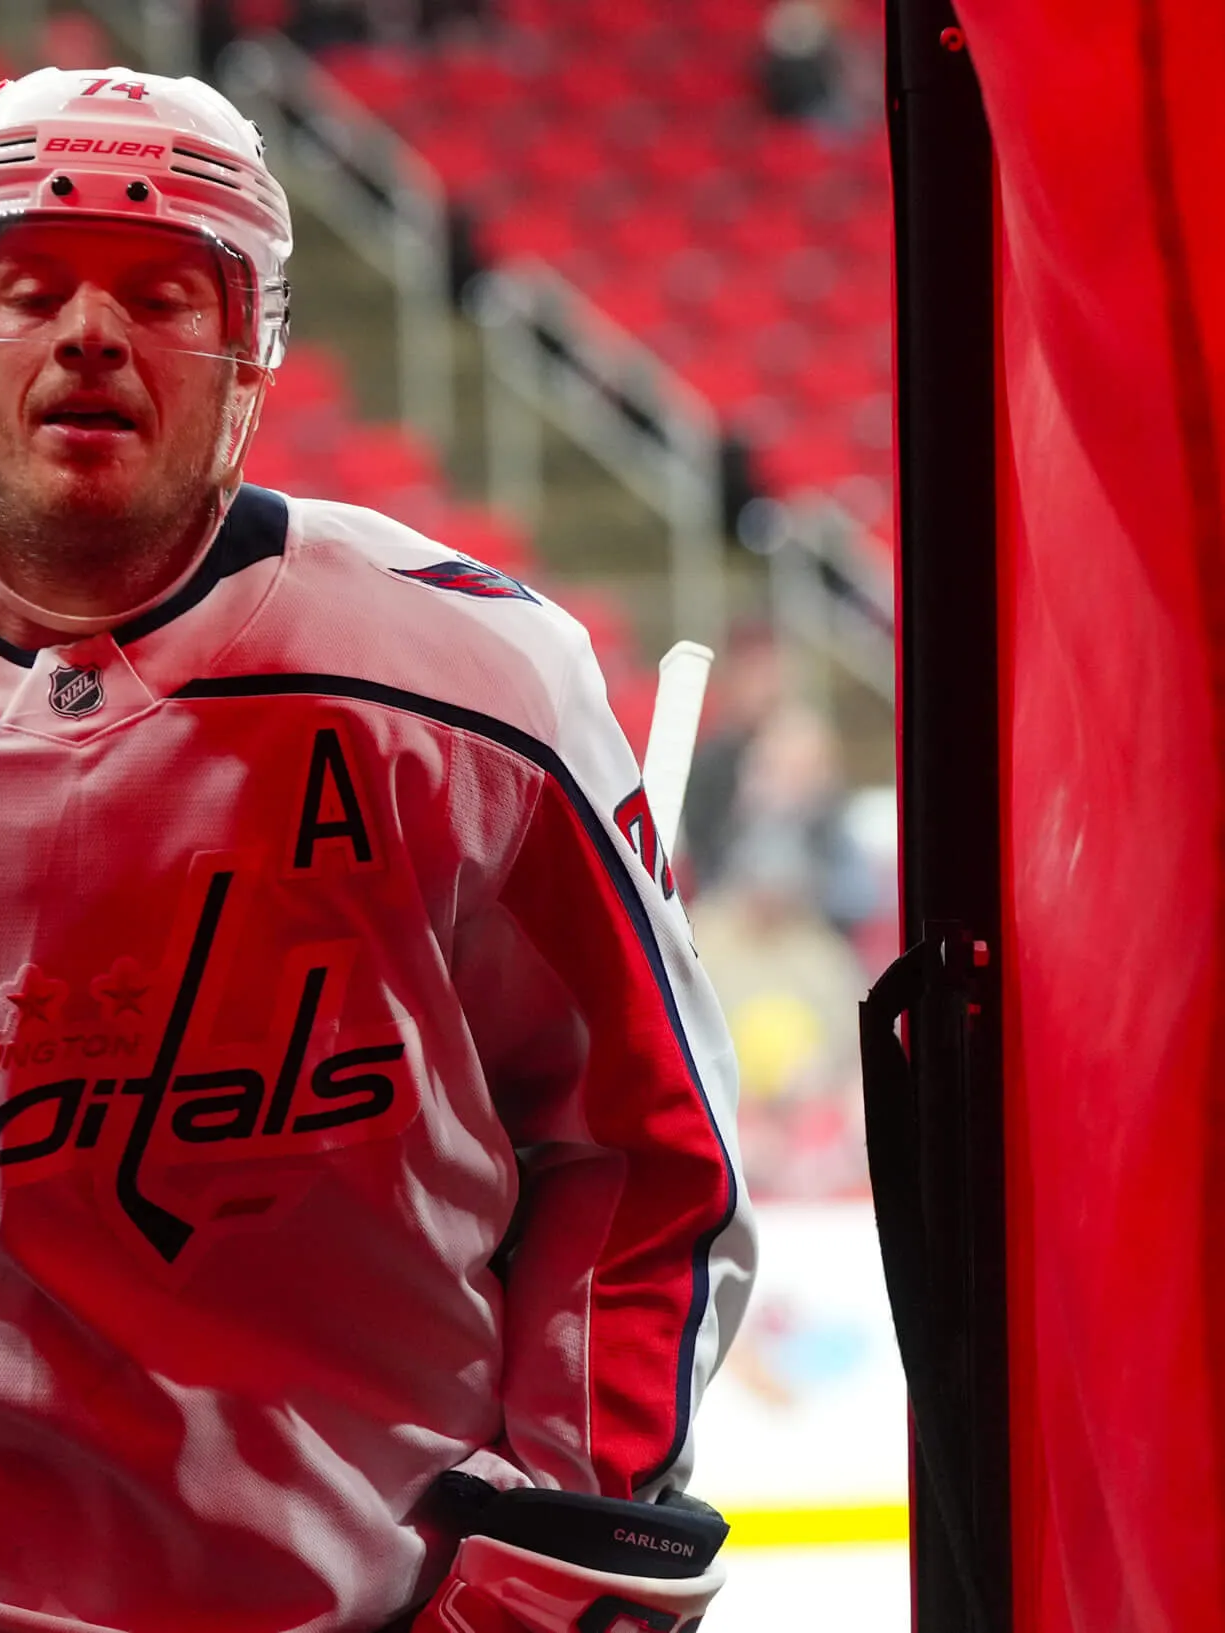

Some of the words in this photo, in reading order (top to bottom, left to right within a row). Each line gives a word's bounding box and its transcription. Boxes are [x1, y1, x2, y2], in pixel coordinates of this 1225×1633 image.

[79, 77, 150, 100] 74
[60, 675, 94, 707] NHL
[293, 728, 373, 868] A
[613, 1528, 695, 1558] CARLSON
